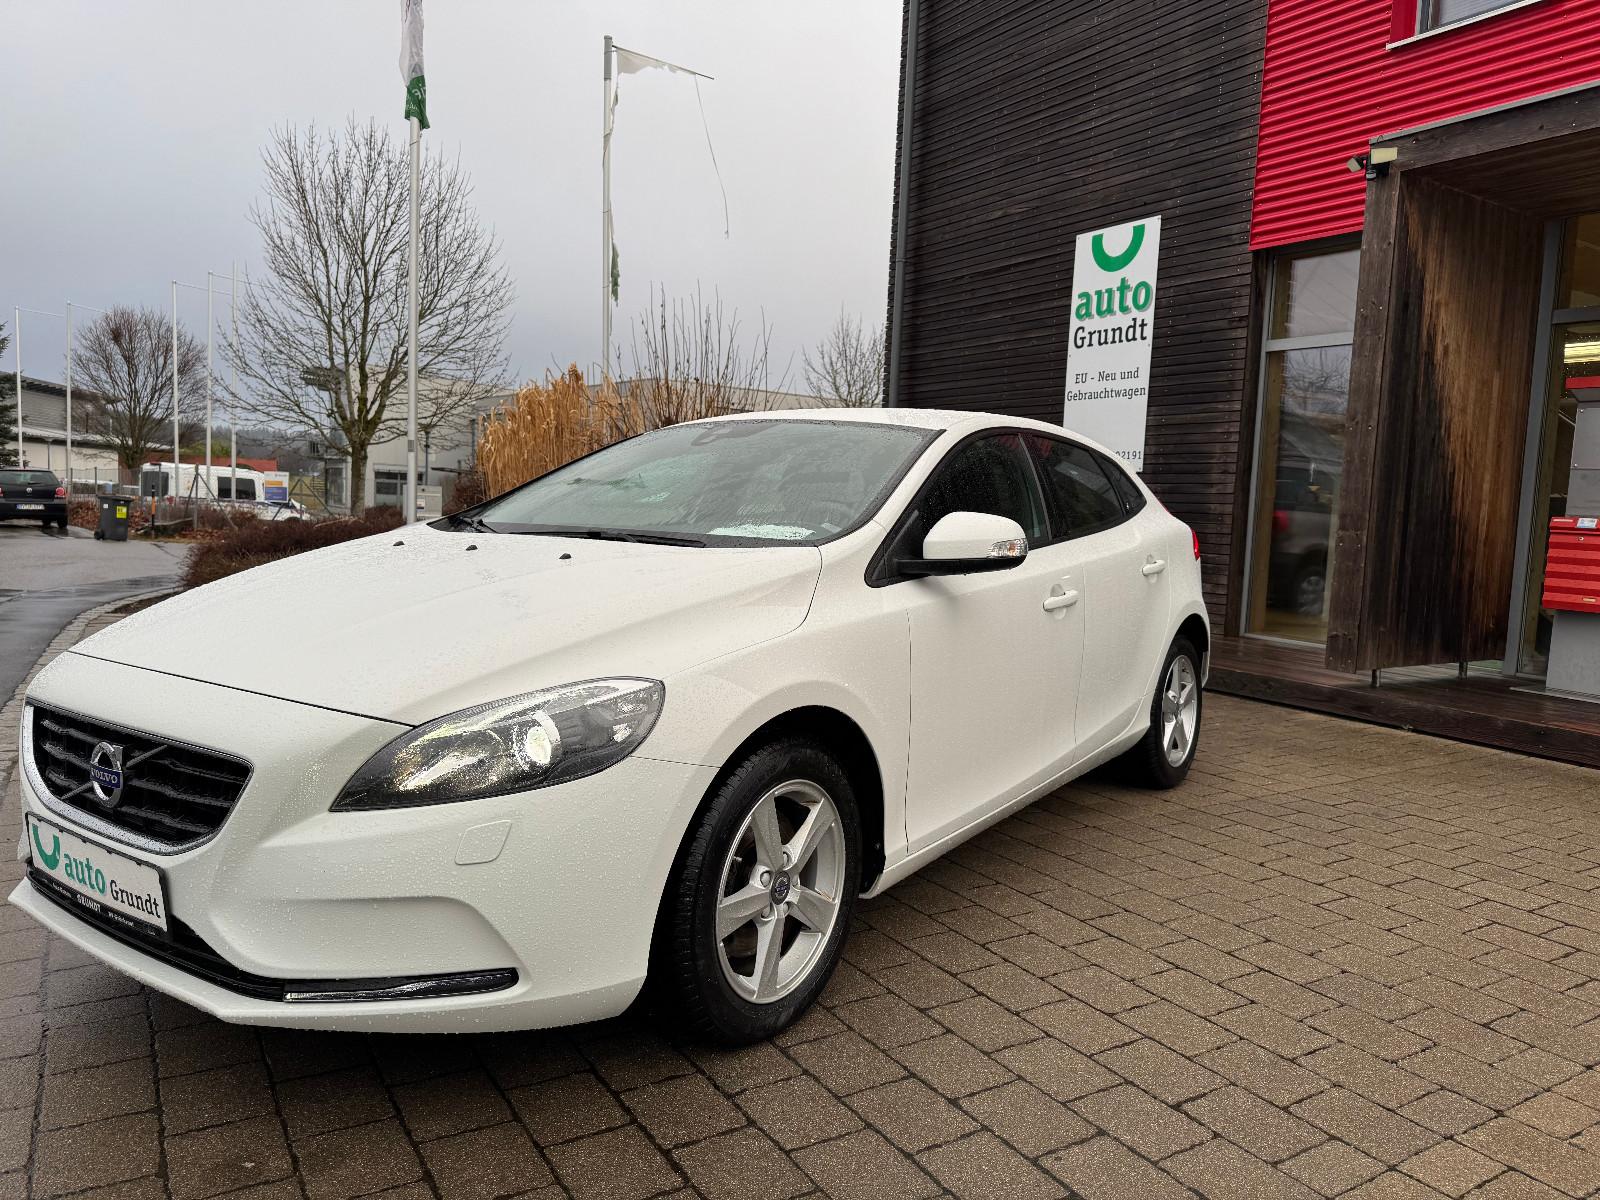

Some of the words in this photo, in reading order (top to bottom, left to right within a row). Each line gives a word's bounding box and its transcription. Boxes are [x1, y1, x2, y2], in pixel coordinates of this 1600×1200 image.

[1075, 277, 1153, 321] auto
[1073, 317, 1147, 349] Grundt
[1075, 373, 1088, 384] EU
[1098, 371, 1117, 382] Neu
[1120, 367, 1139, 380] und
[1066, 387, 1146, 402] Gebrauchtwagen
[91, 768, 118, 784] VOLVO
[63, 852, 107, 896] auto
[109, 880, 161, 919] Grundt
